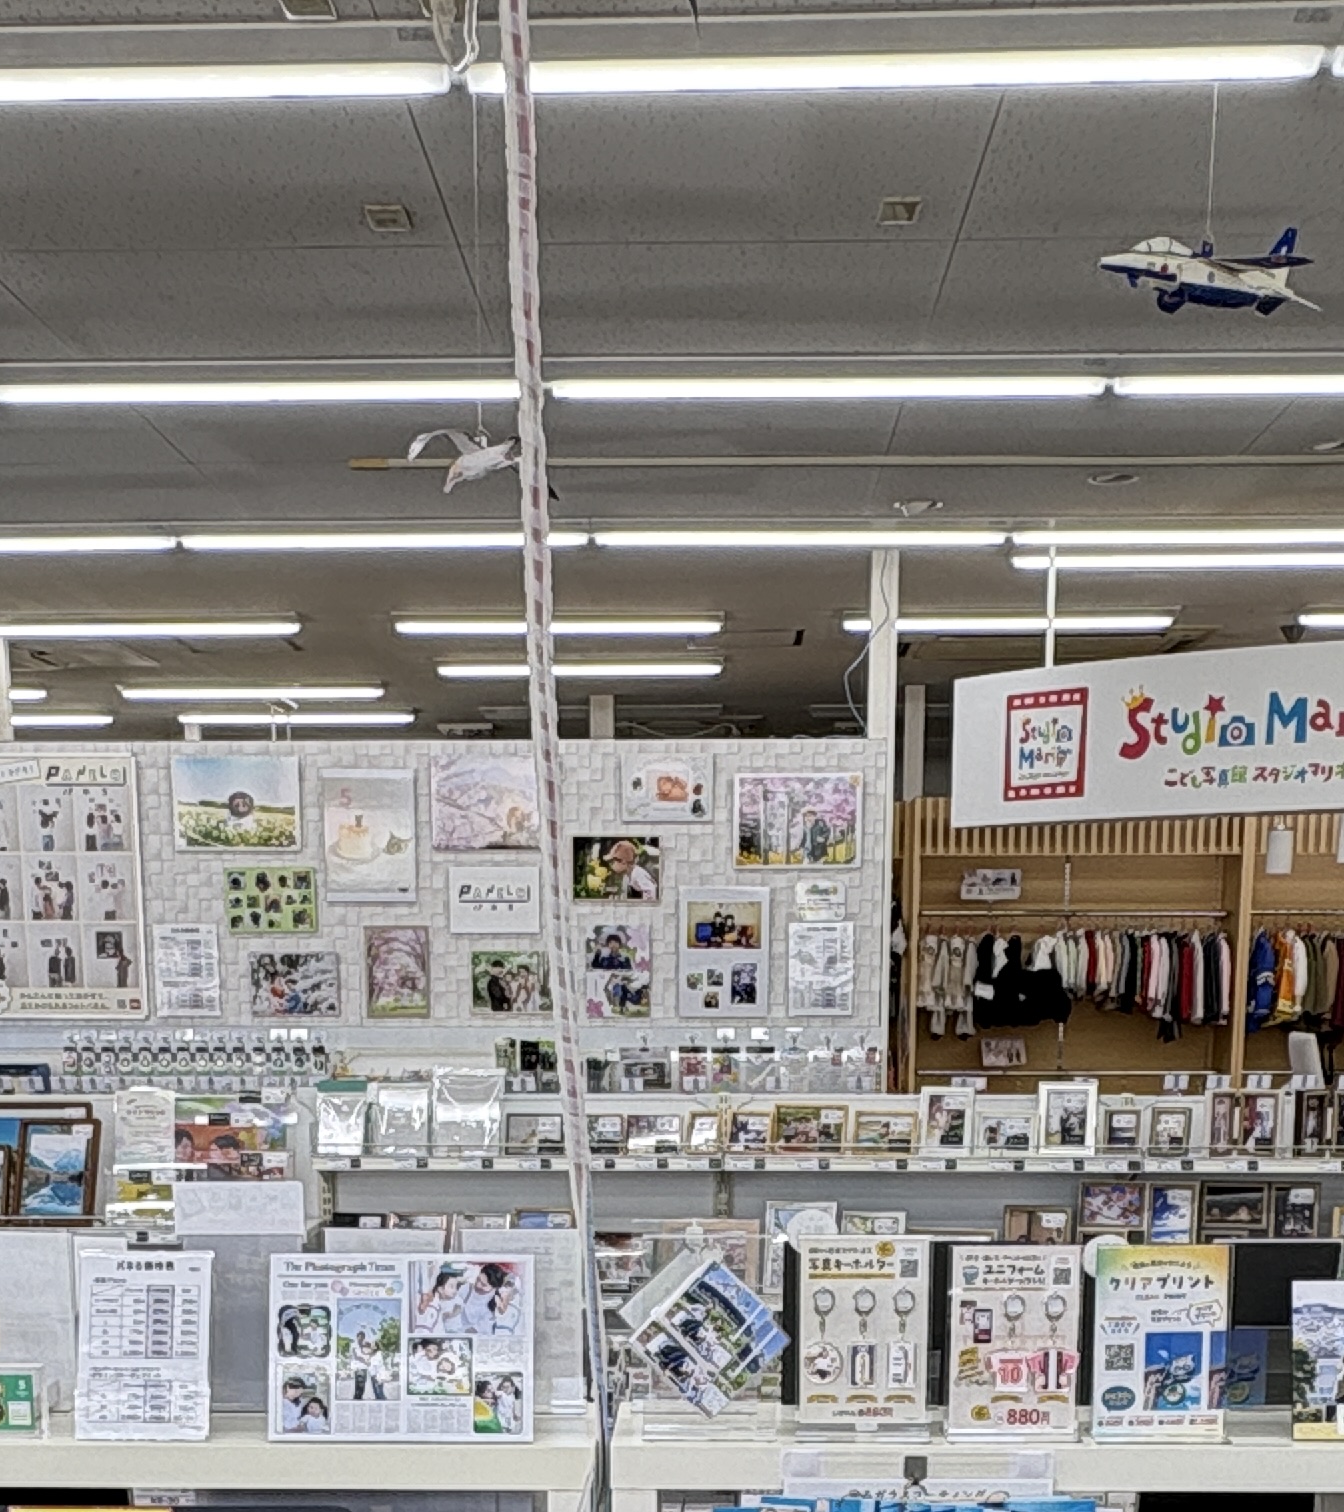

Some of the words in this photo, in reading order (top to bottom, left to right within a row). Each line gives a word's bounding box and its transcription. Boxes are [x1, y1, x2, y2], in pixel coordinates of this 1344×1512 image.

[1163, 765, 1248, 788] こども写真館
[808, 1258, 895, 1271] 写真キーホルダー
[982, 1264, 1046, 1276] ユニフォーム
[1109, 1273, 1215, 1291] クリアプリント
[1006, 1407, 1051, 1426] 880円
